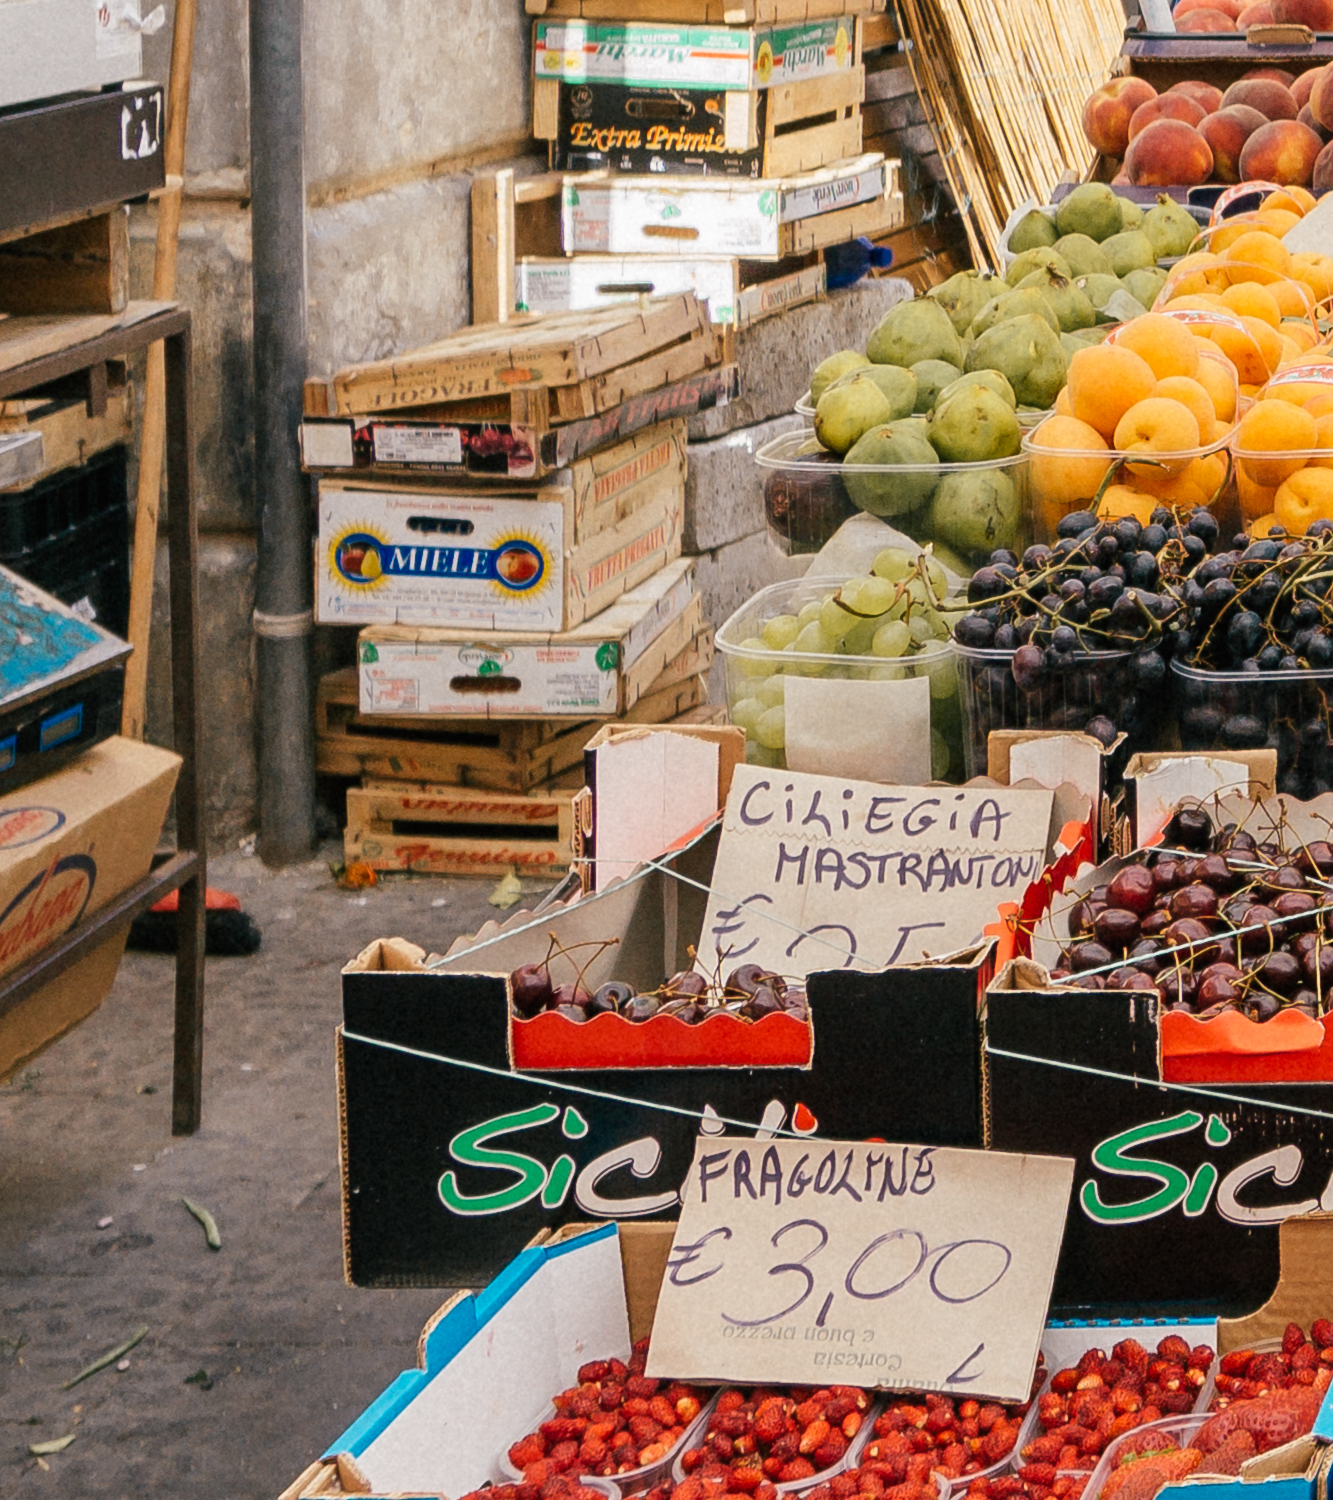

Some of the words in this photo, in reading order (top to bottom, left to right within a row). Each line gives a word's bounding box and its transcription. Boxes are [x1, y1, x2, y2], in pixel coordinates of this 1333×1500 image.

[595, 43, 693, 65] Marchi
[781, 45, 828, 76] Marchi
[571, 122, 641, 152] Extra
[388, 547, 489, 575] MIELE
[711, 893, 773, 960] €
[666, 1229, 726, 1287] €
[721, 1217, 1012, 1330] 3,00
[804, 1327, 857, 1347] buon
[862, 1329, 875, 1343] e
[813, 1352, 903, 1373] Cortesia
